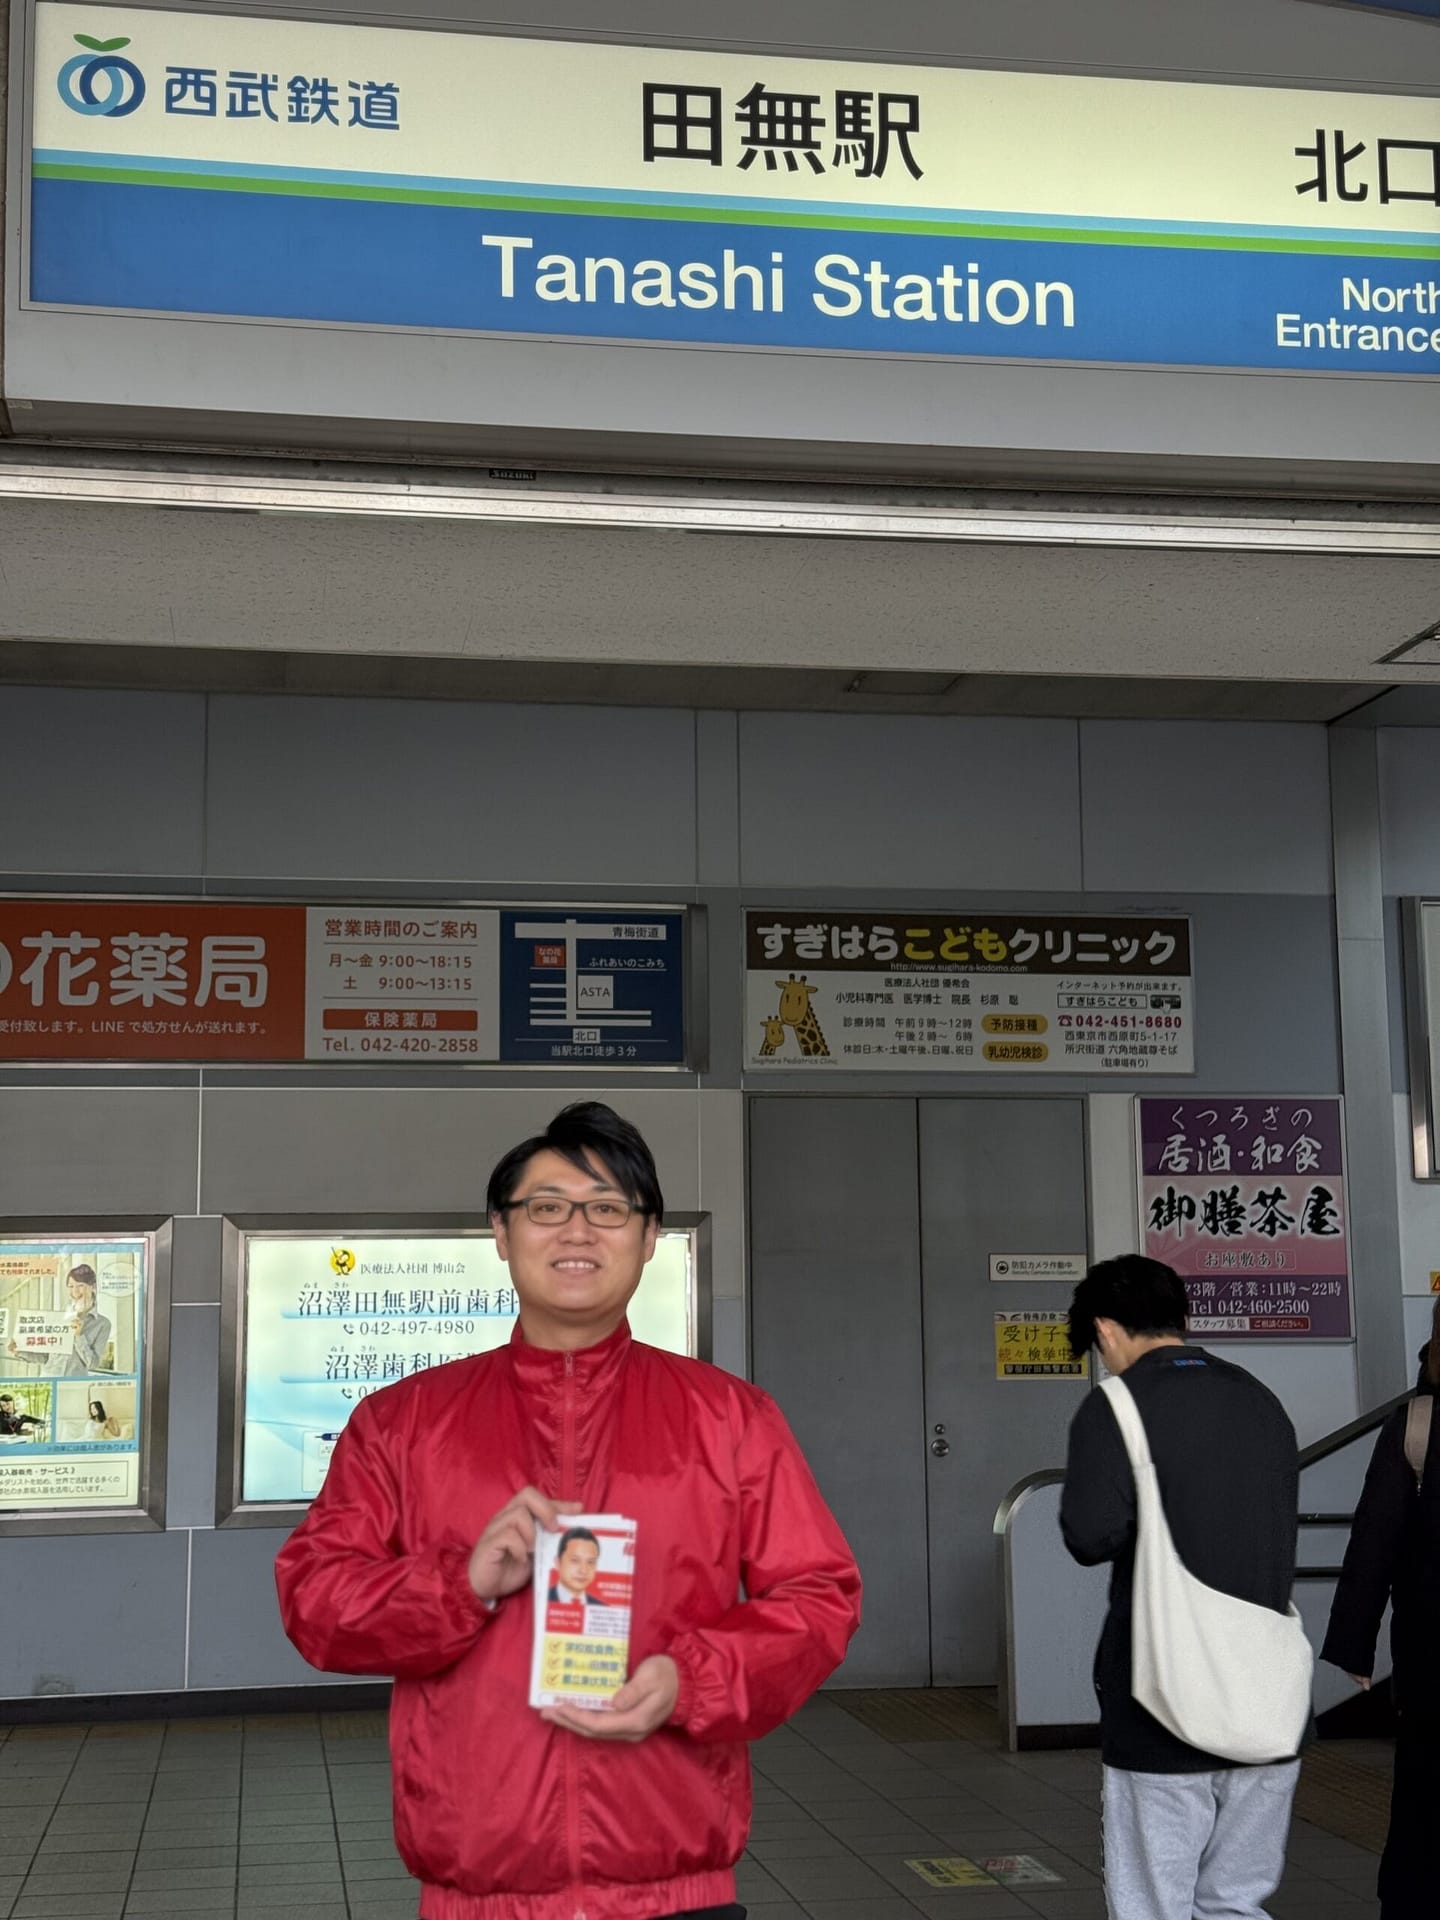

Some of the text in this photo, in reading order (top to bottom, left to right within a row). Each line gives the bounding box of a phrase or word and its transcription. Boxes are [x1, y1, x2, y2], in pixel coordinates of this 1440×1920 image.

[165, 66, 400, 130] 西武鉄道
[643, 82, 924, 180] 田無駅
[1294, 129, 1440, 207] 北口
[482, 234, 1075, 327] Tanashi Station
[324, 919, 478, 939] 営業時間のご案内
[612, 926, 659, 938] 青梅街道
[757, 923, 1176, 966] すぎはらこどもクリニック
[328, 953, 472, 969] 月〜金 9:00〜18:15
[588, 957, 665, 969] ふれあいのこみち
[0, 931, 268, 1008] 花薬局
[342, 976, 472, 991] 土 9:00〜13:15
[884, 978, 940, 988] 医療法人社団
[580, 986, 611, 998] ASTA
[835, 992, 894, 1005] 小児科専門医
[904, 993, 943, 1005] 医学博士
[951, 994, 971, 1005] 院長
[980, 994, 999, 1006] 杉原
[1066, 996, 1138, 1008] すぎはらこども
[92, 1021, 125, 1034] LINE
[131, 1020, 267, 1035] で処方せんが送れます。
[364, 1012, 438, 1029] 保険薬局
[843, 1017, 886, 1028] 診療時間
[991, 1018, 1038, 1032] 予防接種
[1076, 1015, 1182, 1028] 042-451-8680
[575, 1031, 598, 1042] 北口
[1064, 1031, 1177, 1042] 西東京市西原町5-1-17
[322, 1037, 478, 1053] Tel. 042-420-2858
[1064, 1044, 1178, 1056] 所沢街道 六角地蔵尊そば
[988, 1046, 1043, 1060] 乳幼児検診
[820, 1057, 839, 1065] Clinic
[1171, 1106, 1312, 1131] くつろぎの
[1158, 1133, 1322, 1174] 居酒・和食
[1148, 1185, 1341, 1238] 御膳茶屋
[1205, 1251, 1287, 1268] お座敷あり
[360, 1263, 466, 1275] 医療法人社団 博山会
[298, 1288, 518, 1317] 沼澤田無駅前歯科
[1189, 1300, 1310, 1314] Tel 042-460-2500
[359, 1320, 475, 1335] 042-497-4980
[1003, 1325, 1070, 1343] 受け子
[326, 1353, 475, 1381] 沼澤歯科
